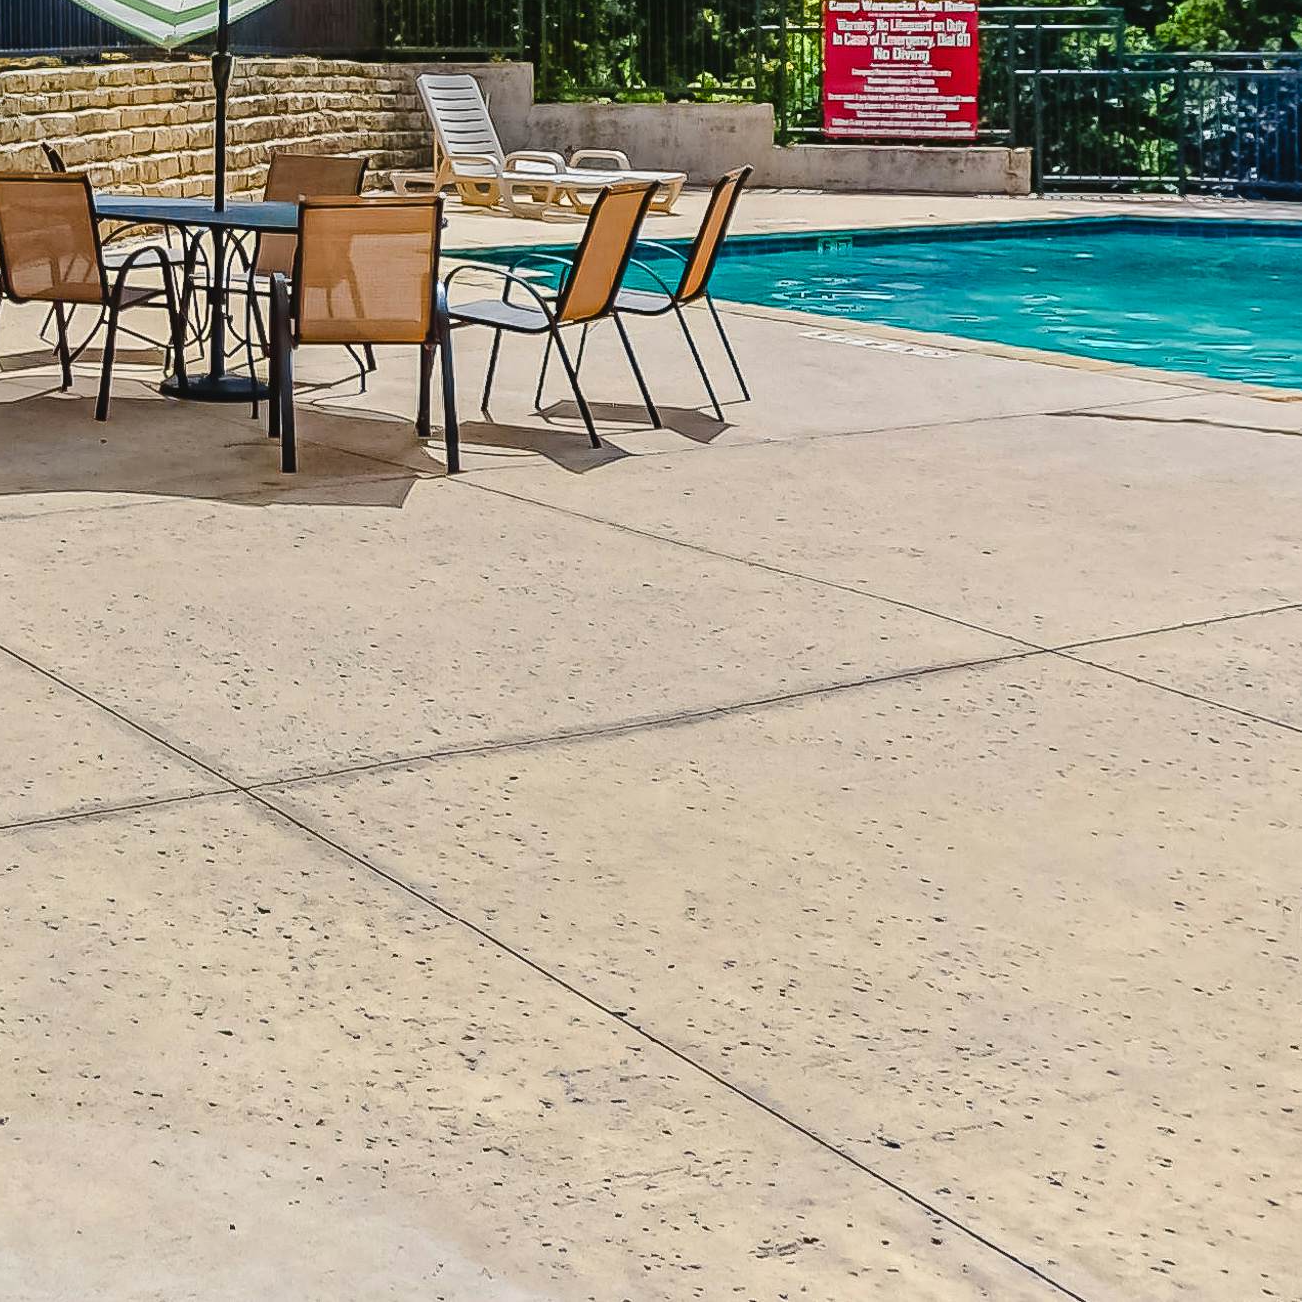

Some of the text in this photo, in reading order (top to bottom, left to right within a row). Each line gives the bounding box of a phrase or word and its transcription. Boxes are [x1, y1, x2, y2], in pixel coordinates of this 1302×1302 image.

[918, 0, 943, 12] Pool
[876, 18, 889, 31] No
[890, 19, 932, 34] Lifeguard
[946, 18, 967, 33] Duty
[832, 32, 843, 46] In
[844, 32, 868, 46] Case
[869, 32, 880, 46] of
[937, 33, 956, 47] Dial
[956, 33, 971, 47] 911
[874, 47, 929, 63] No Diving
